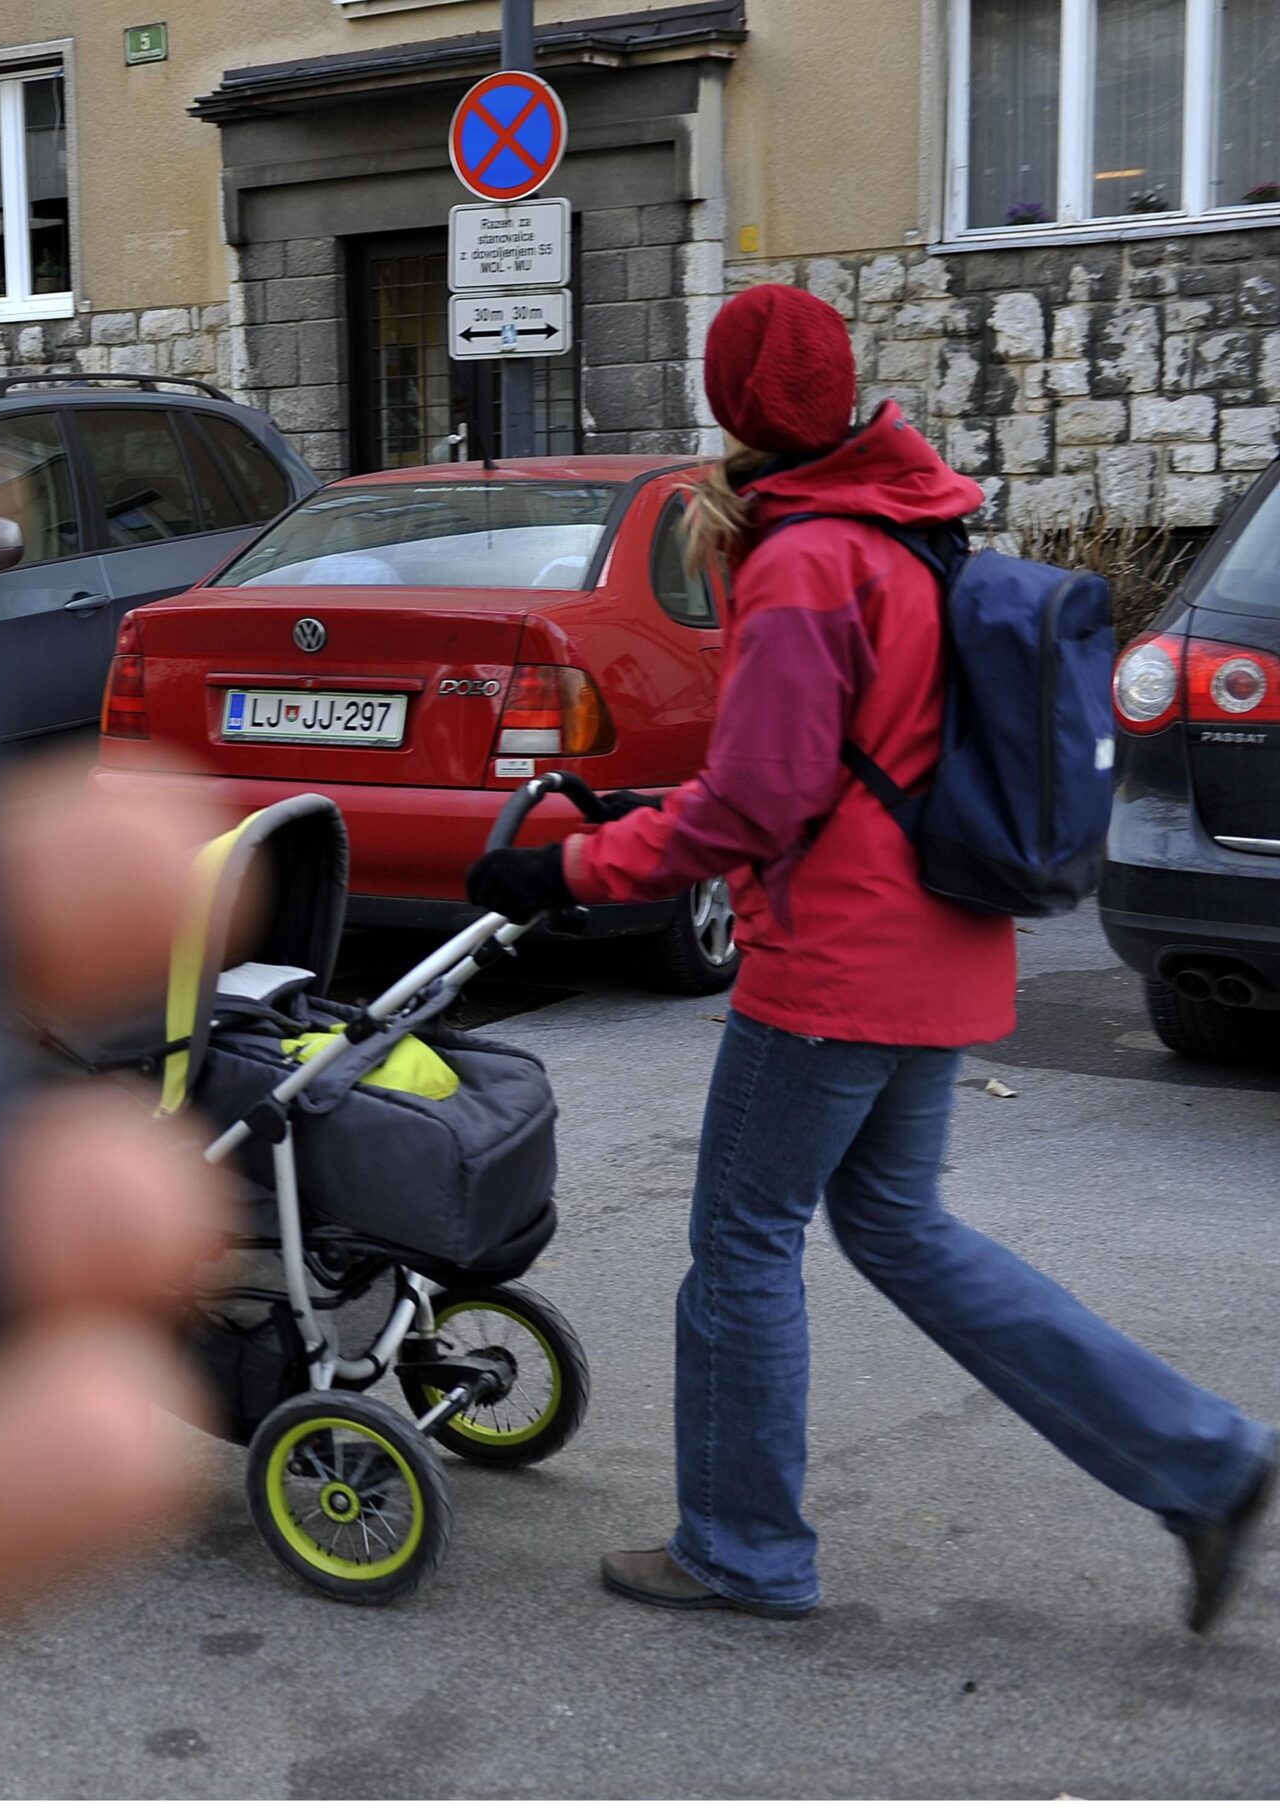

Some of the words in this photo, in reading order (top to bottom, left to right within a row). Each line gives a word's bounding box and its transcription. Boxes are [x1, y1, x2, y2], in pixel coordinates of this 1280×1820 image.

[140, 32, 150, 50] 5
[480, 218, 513, 230] Razen
[517, 218, 531, 228] za
[460, 251, 468, 261] z
[473, 307, 504, 322] 30m
[511, 306, 543, 320] 30m
[438, 679, 501, 696] POLO
[251, 698, 282, 728] LJ
[303, 699, 392, 732] JJ-297
[1200, 731, 1268, 743] PASSAT
